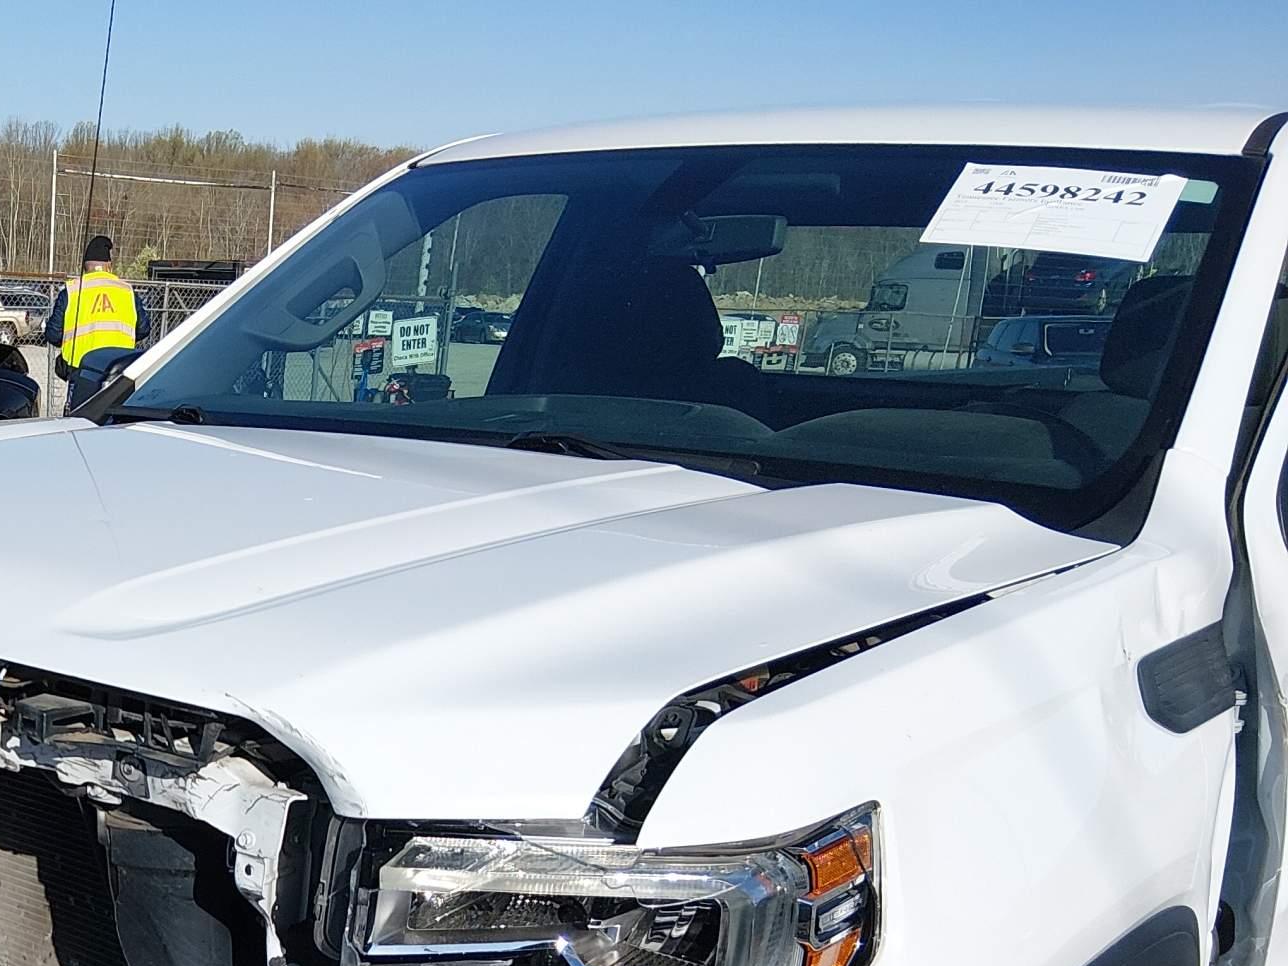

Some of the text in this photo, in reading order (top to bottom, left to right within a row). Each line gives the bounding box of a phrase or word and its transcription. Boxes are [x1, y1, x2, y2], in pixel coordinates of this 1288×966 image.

[973, 180, 1147, 207] 44598242
[399, 325, 411, 337] DO
[413, 323, 430, 336] NOT
[724, 324, 737, 335] NOT
[401, 337, 427, 351] ENTER
